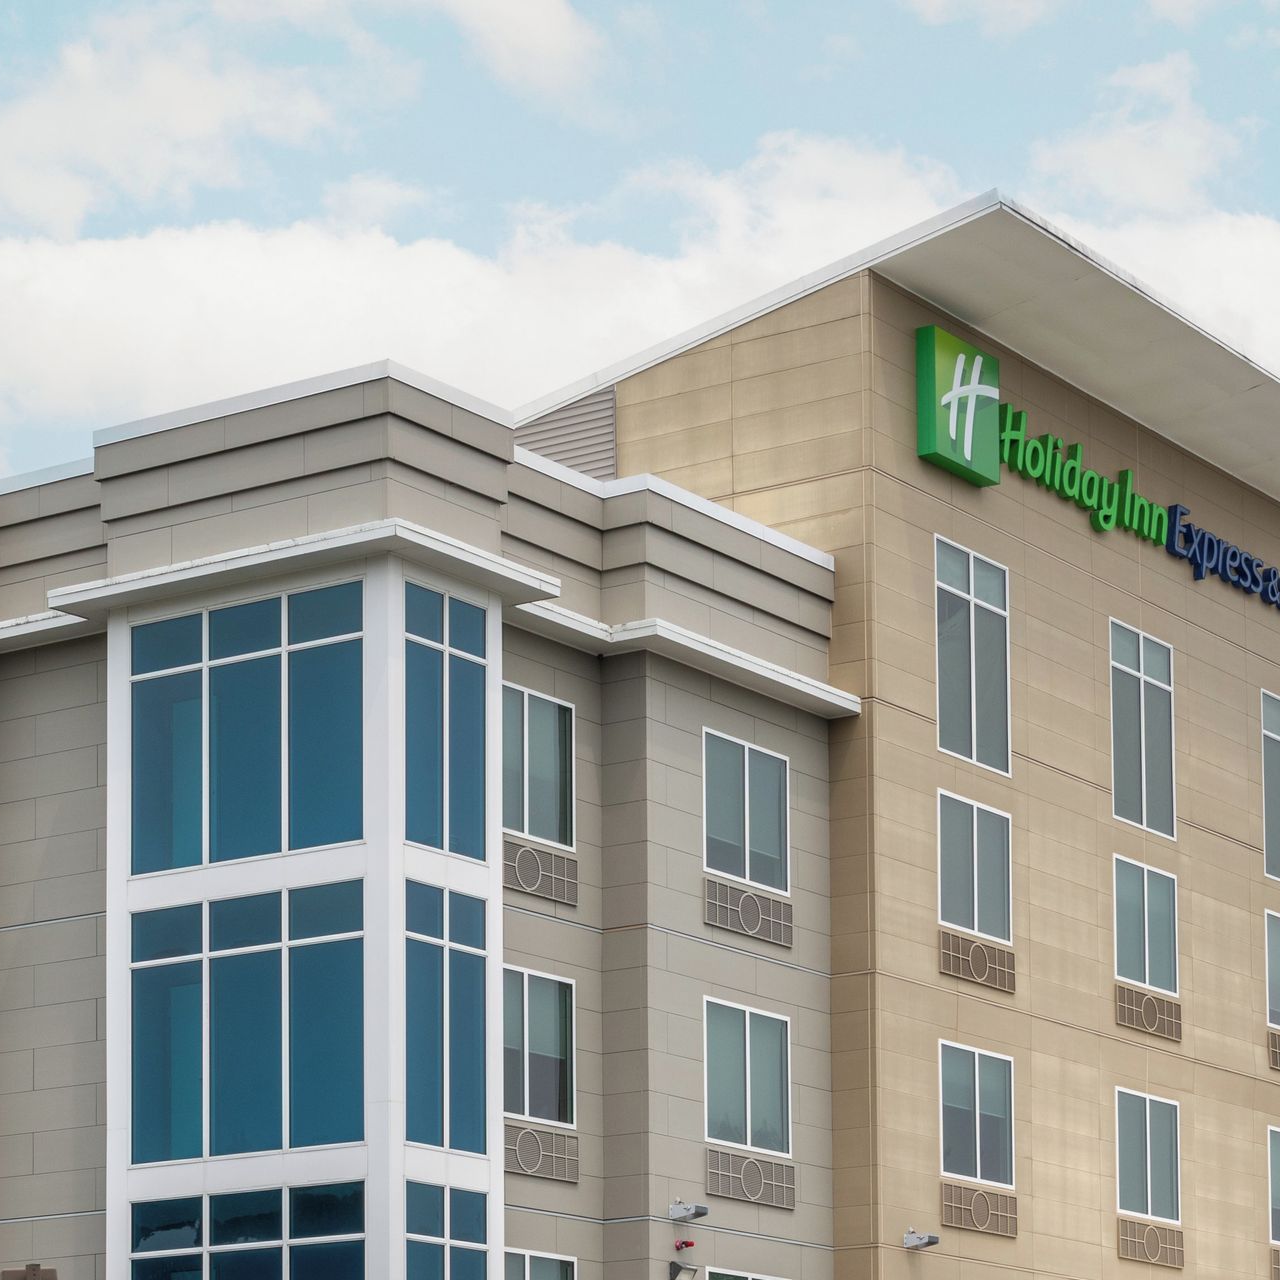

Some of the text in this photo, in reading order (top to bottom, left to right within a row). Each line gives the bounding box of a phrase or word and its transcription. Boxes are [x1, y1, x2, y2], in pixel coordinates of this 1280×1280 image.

[941, 353, 1000, 461] H
[1000, 402, 1120, 532] Holiday
[1119, 468, 1169, 546] Inn
[1167, 503, 1264, 595] Express
[1261, 557, 1280, 605] &
